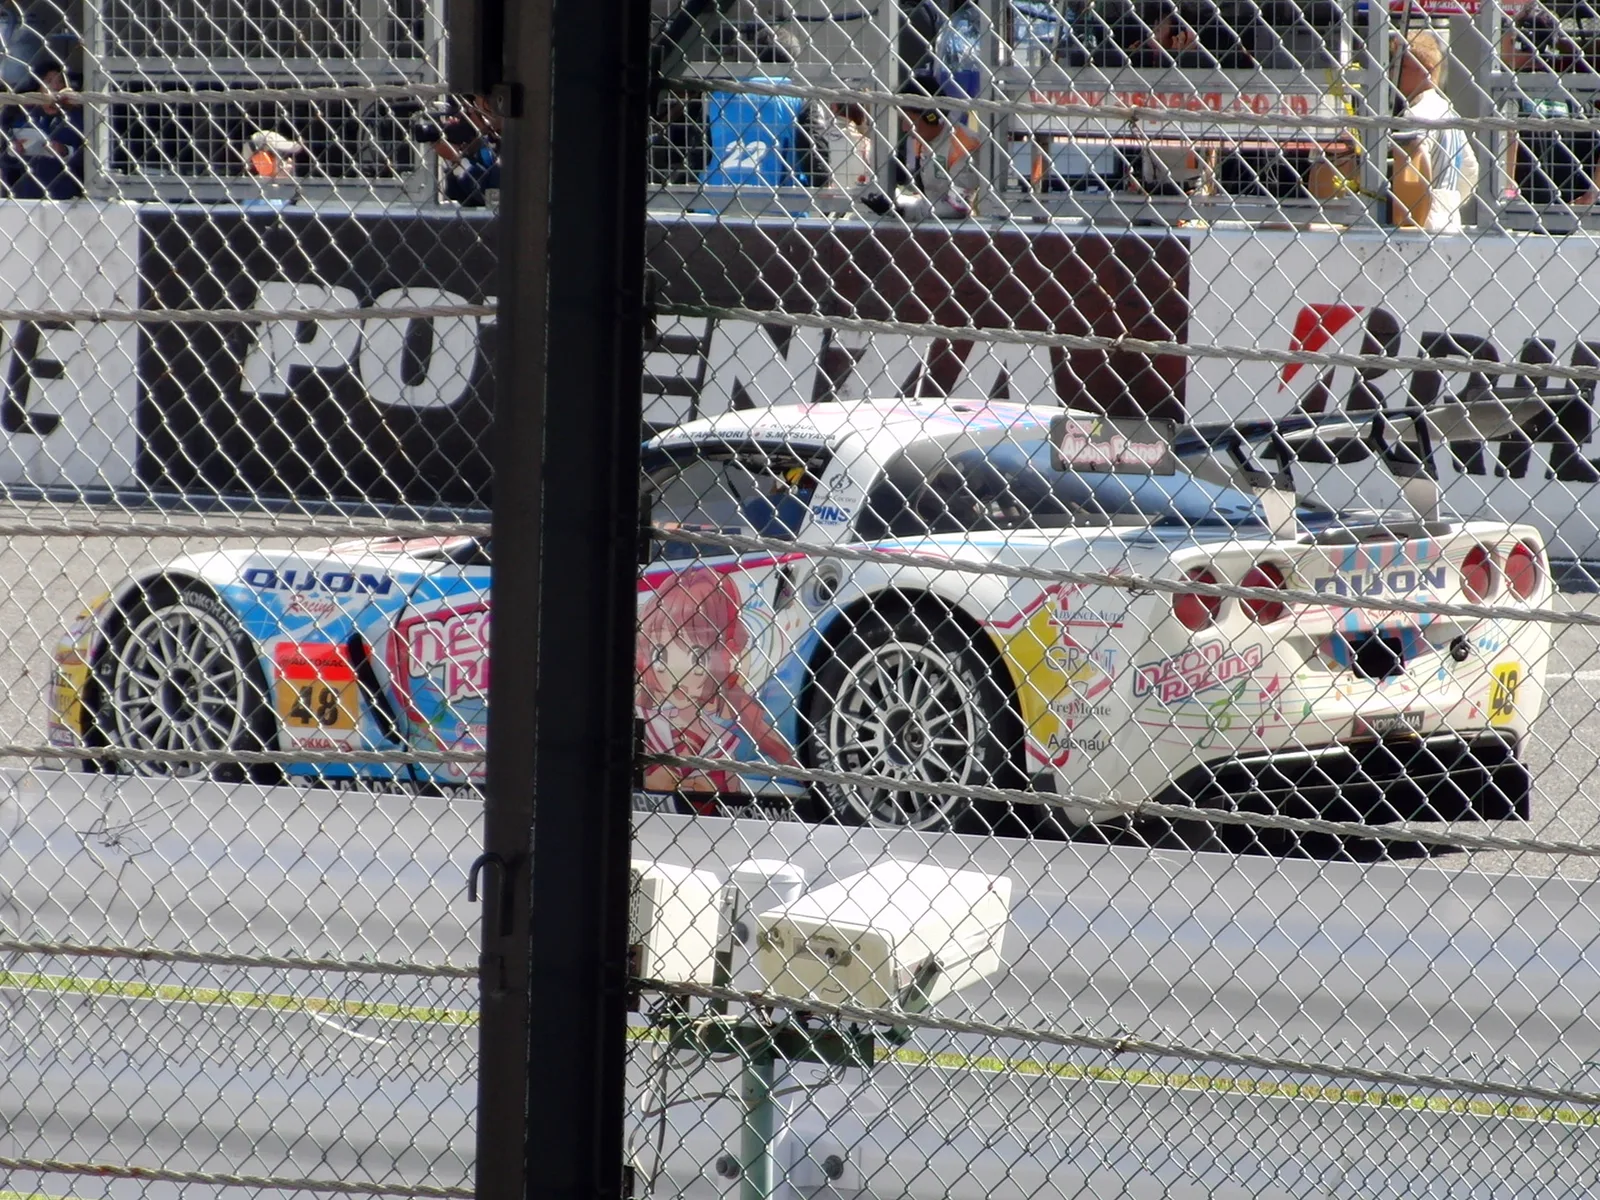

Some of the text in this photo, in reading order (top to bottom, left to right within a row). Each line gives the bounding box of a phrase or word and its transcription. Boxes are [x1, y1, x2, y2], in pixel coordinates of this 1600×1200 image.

[720, 141, 767, 168] 22
[813, 506, 850, 522] PINS
[286, 593, 337, 620] Racing
[290, 685, 339, 726] 48
[1491, 669, 1518, 716] 48
